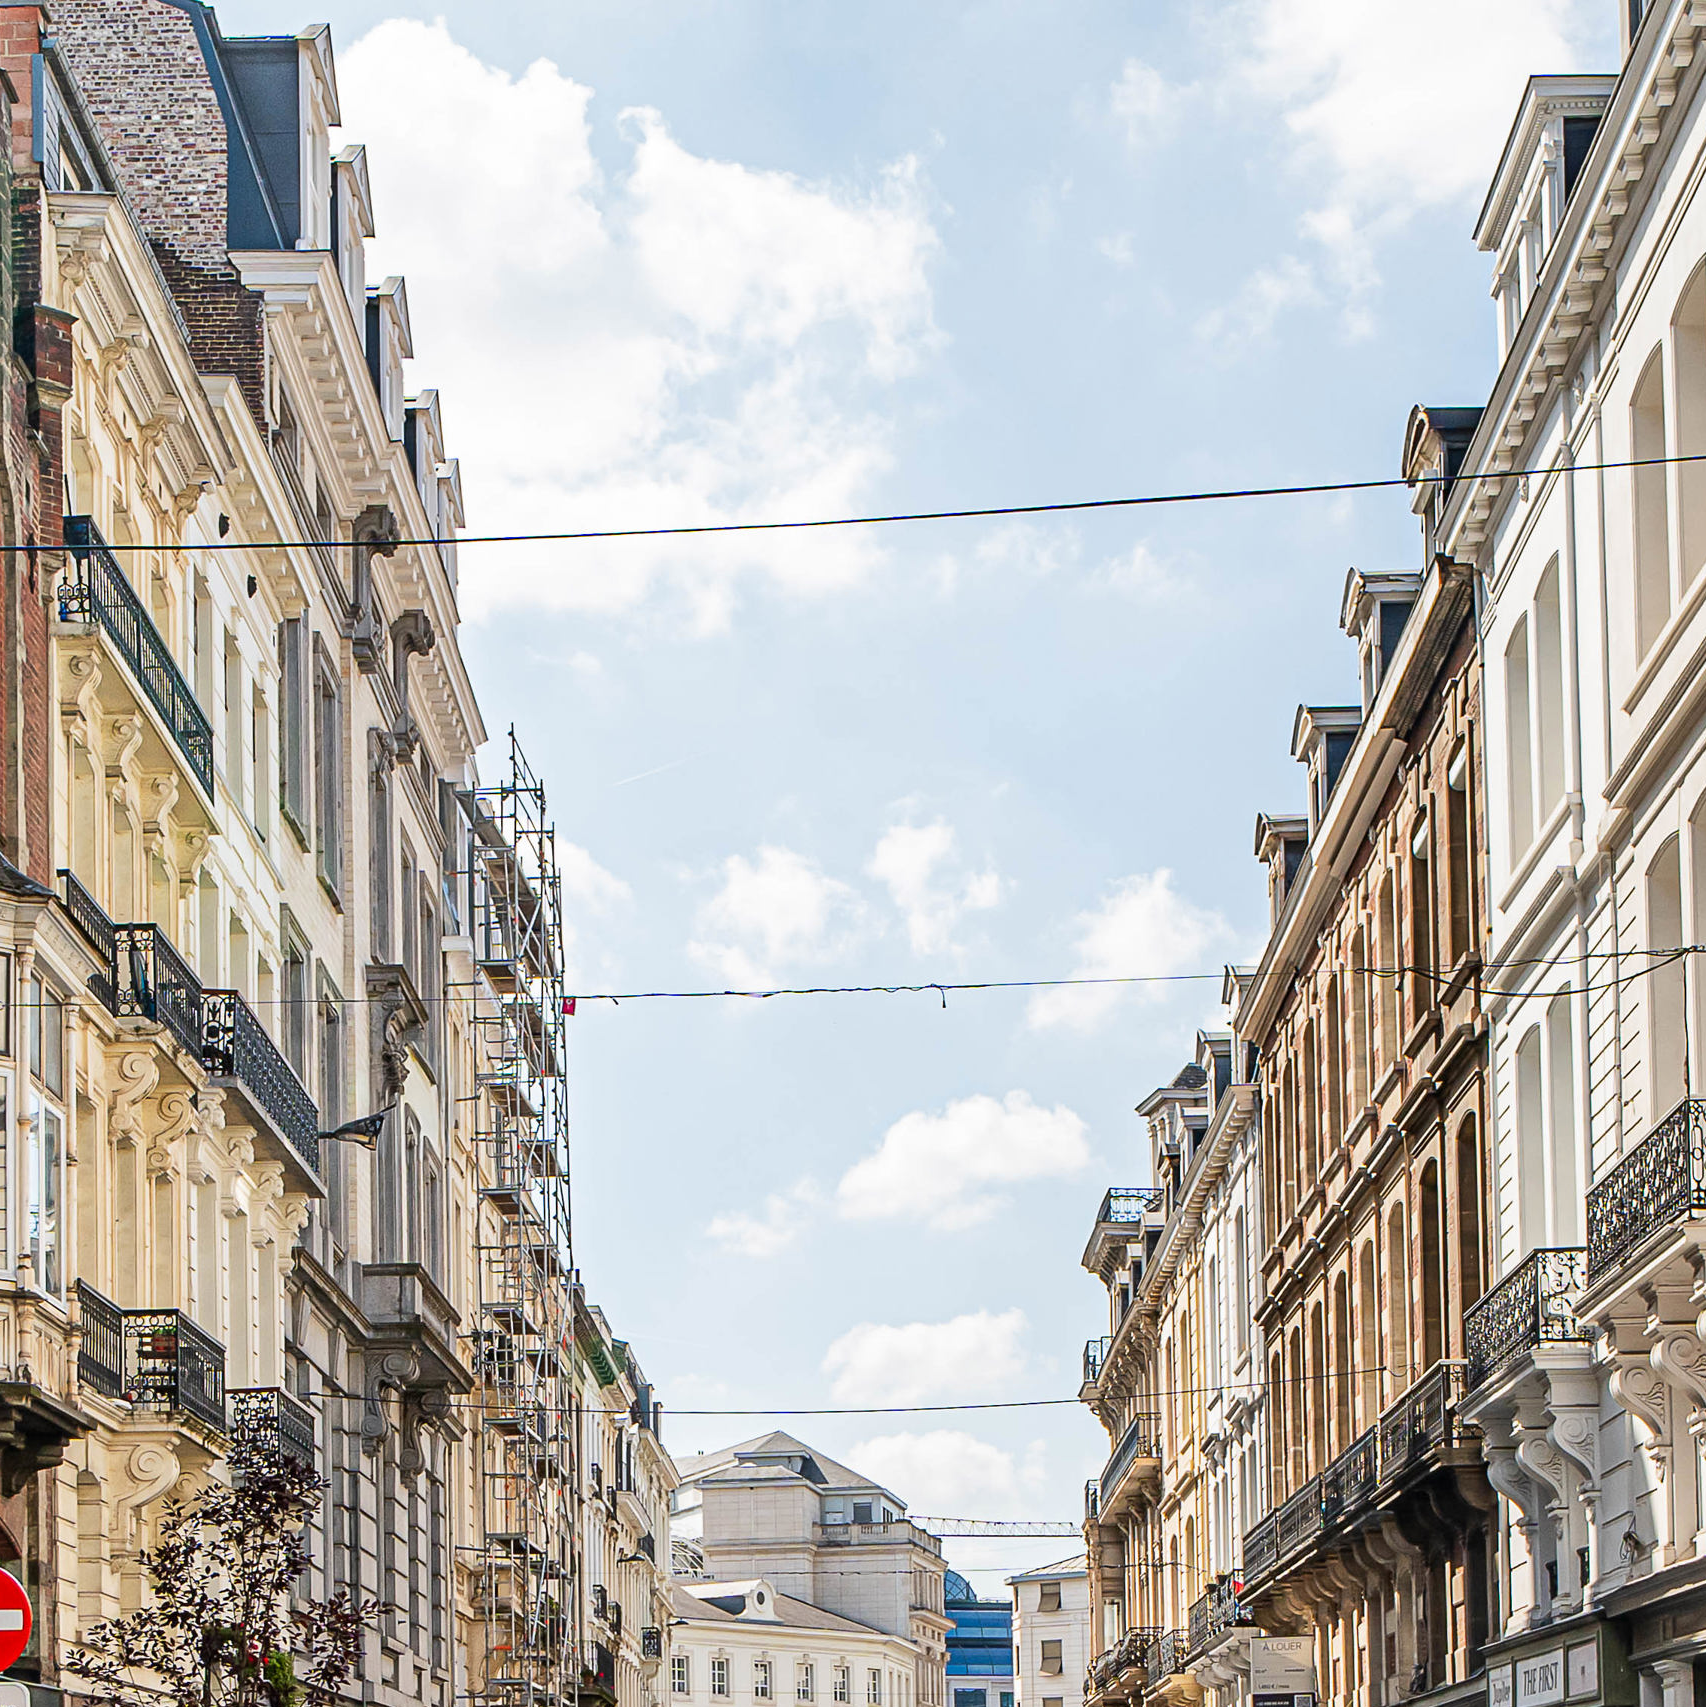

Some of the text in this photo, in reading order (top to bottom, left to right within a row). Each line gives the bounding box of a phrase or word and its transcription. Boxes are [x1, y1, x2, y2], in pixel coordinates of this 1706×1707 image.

[1271, 1641, 1302, 1652] LOUER
[1523, 1661, 1559, 1697] THE FIRST
